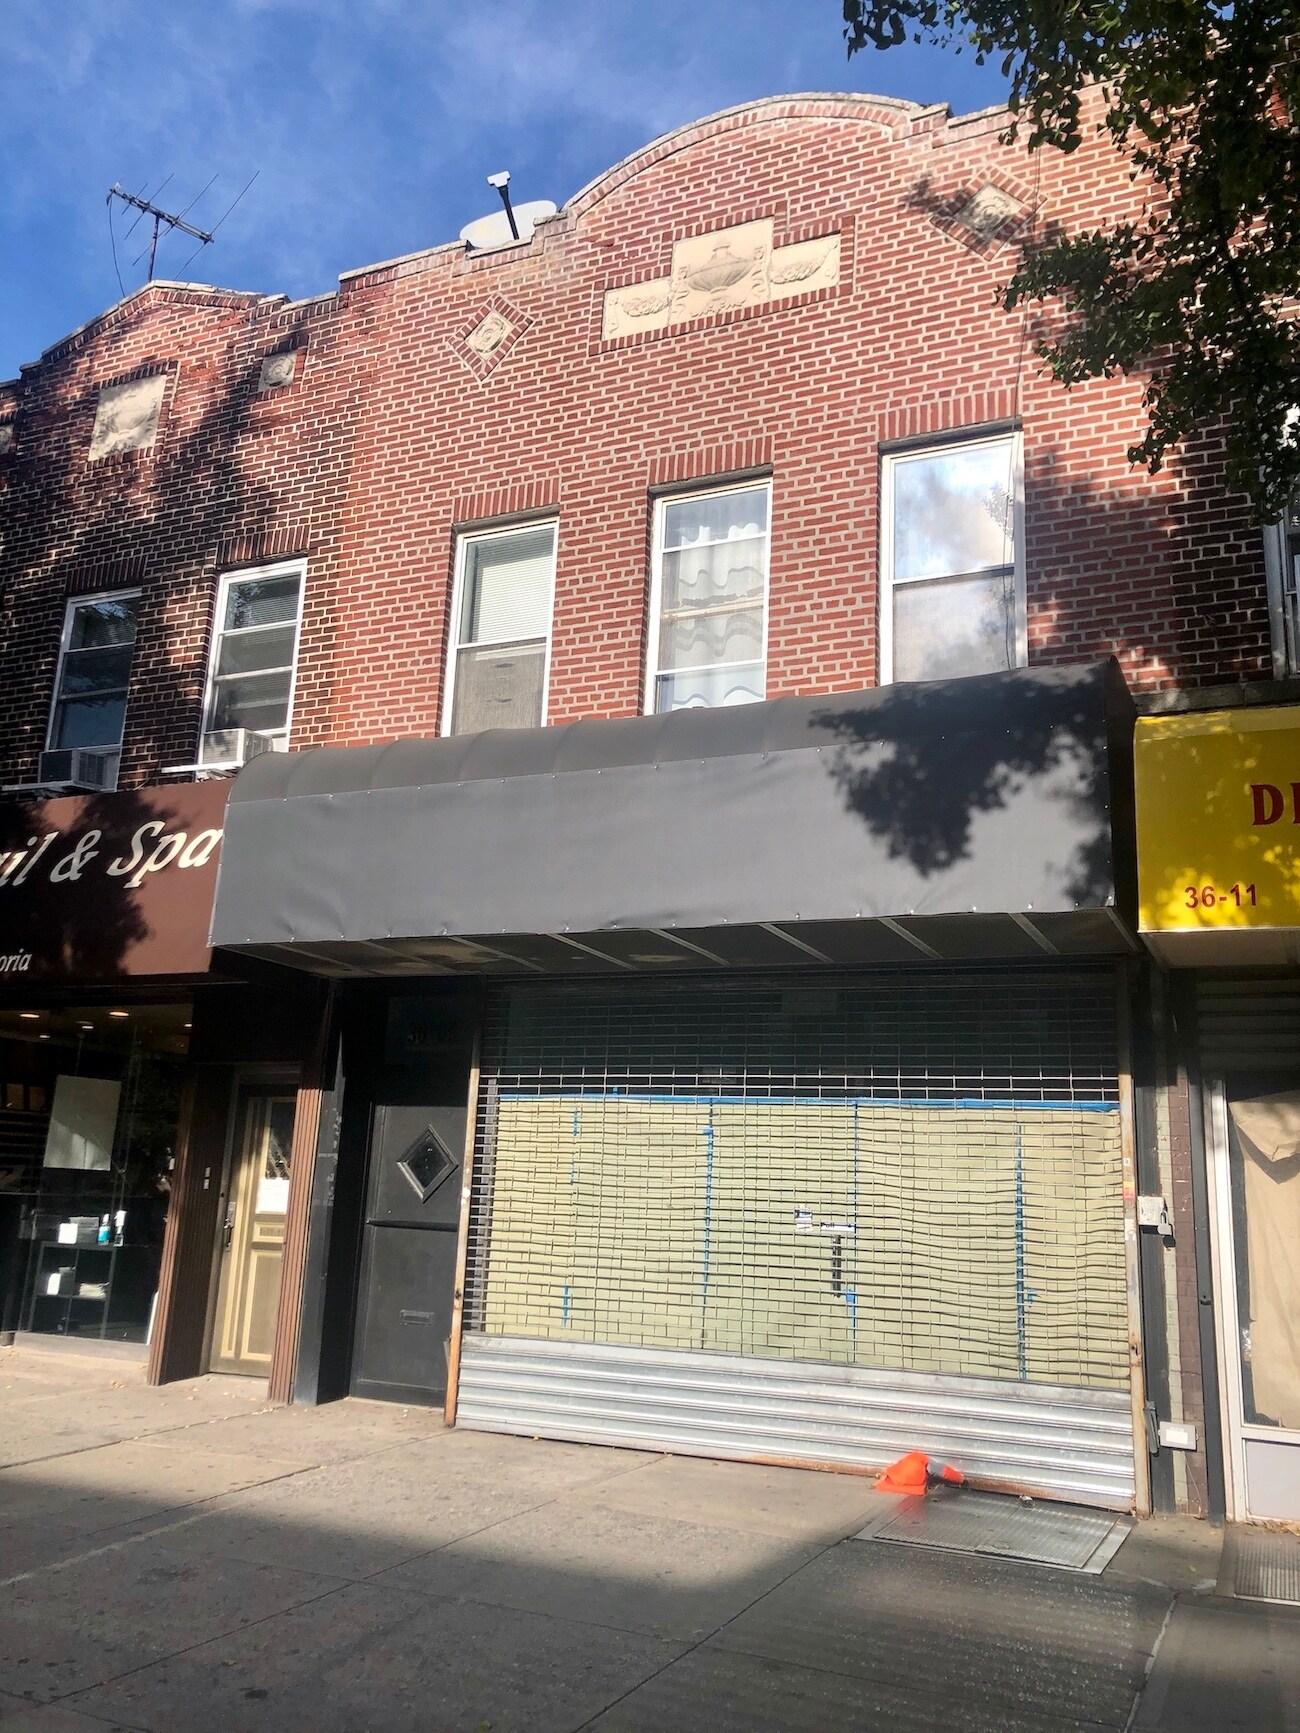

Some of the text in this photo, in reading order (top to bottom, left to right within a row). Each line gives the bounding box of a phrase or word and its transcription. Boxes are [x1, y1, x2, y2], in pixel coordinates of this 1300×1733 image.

[50, 829, 102, 883] &
[106, 821, 223, 889] Spa
[1184, 884, 1257, 909] 36-11
